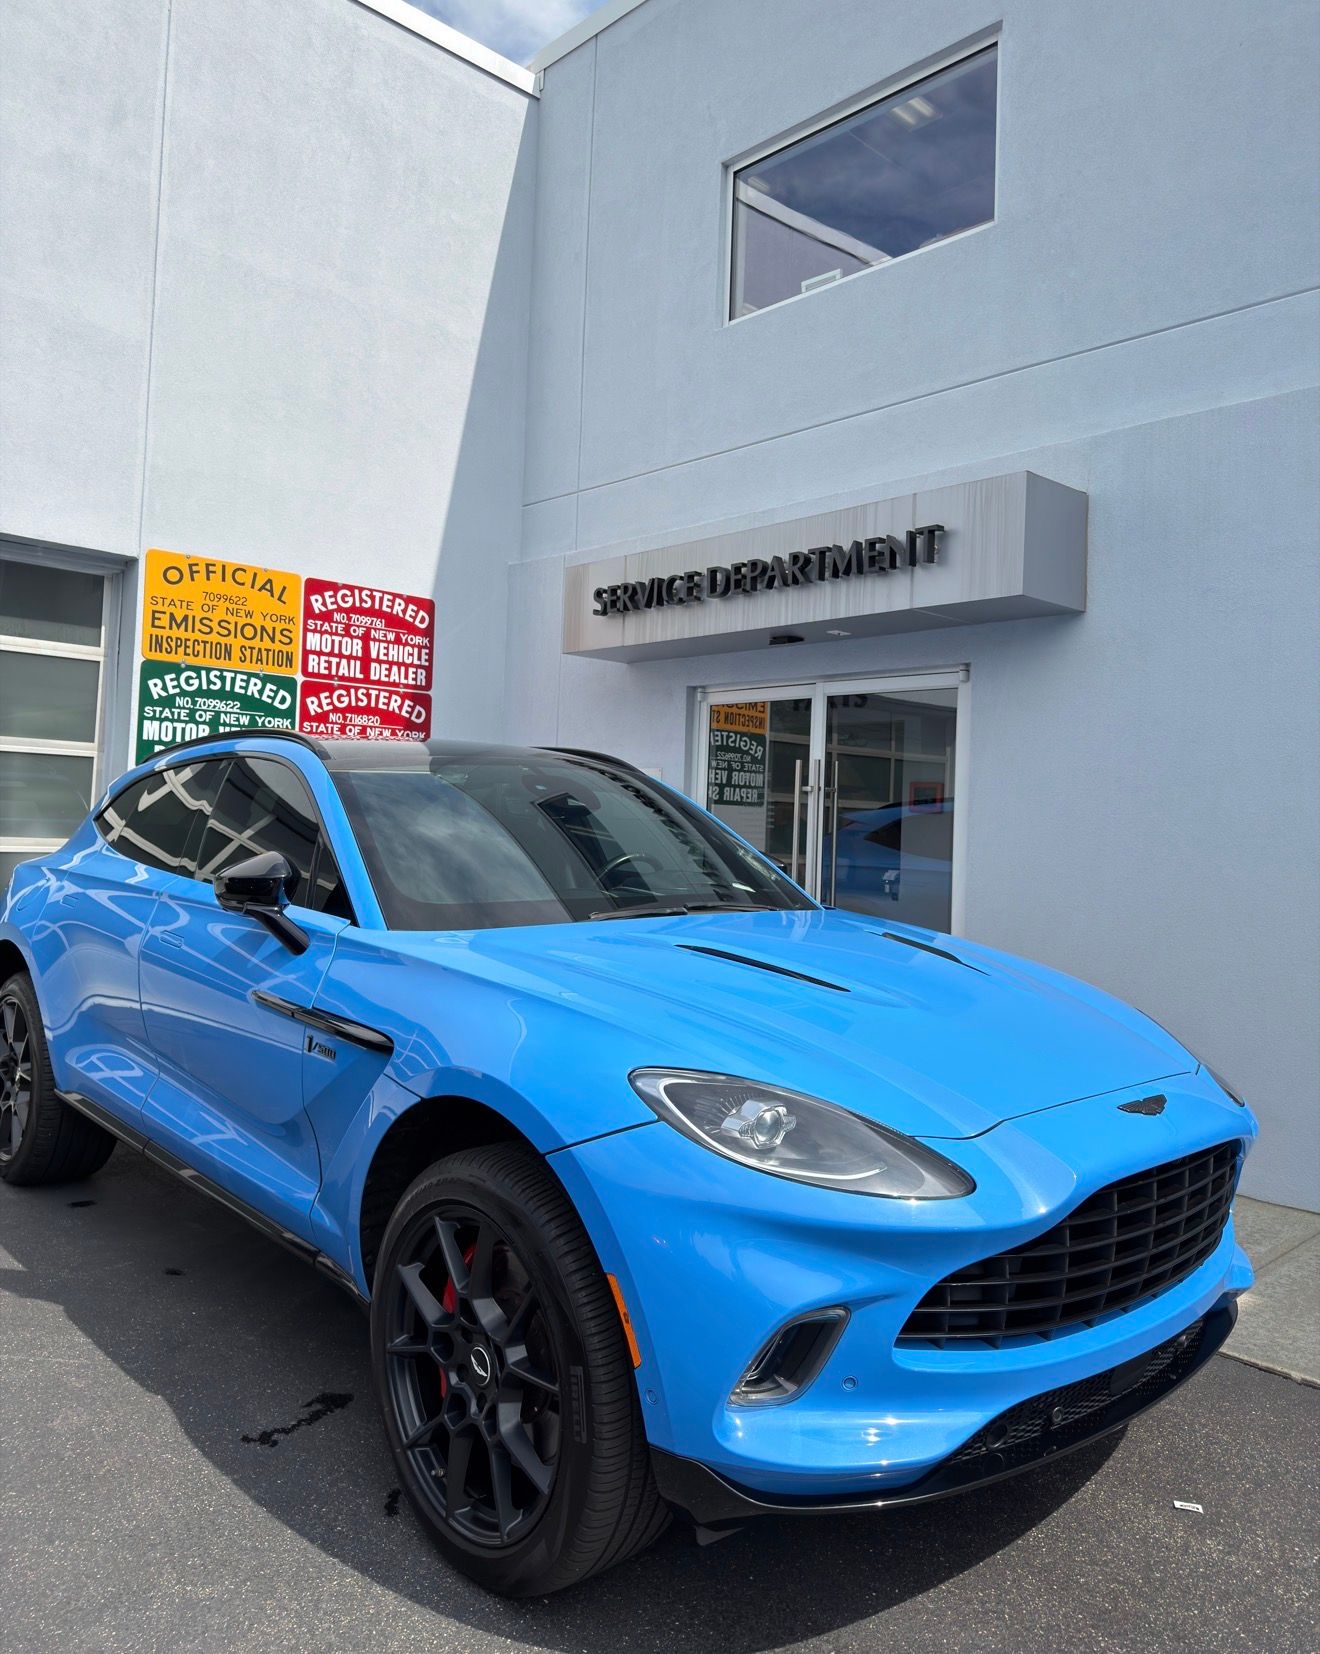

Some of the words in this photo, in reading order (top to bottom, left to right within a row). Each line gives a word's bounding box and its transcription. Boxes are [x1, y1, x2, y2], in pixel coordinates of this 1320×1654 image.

[162, 562, 287, 605] OFFICIAL
[592, 570, 704, 616] SERVICE
[706, 524, 945, 600] DEPARTMENT
[150, 595, 194, 611] STATE
[201, 603, 219, 613] OF
[225, 606, 254, 619] NEW
[260, 611, 296, 626] YORK
[202, 591, 248, 606] 7099622
[310, 589, 430, 629] REGISTERED
[151, 609, 293, 646] EMISSIONS
[306, 619, 345, 634] STATE
[350, 626, 367, 637] OF
[371, 629, 395, 641] NEW
[400, 633, 430, 647] YORK
[350, 614, 385, 628] 7099761
[149, 633, 232, 662] INSPECTION
[239, 644, 294, 669] STATION
[306, 632, 363, 657] MOTOR
[369, 641, 429, 667] VEHICLE
[307, 654, 364, 679] RETAIL
[370, 662, 426, 686] DEALER
[147, 670, 292, 710] REGISTERED
[194, 697, 241, 712] 7099622
[305, 688, 426, 724] REGISTERED
[143, 706, 190, 721] STATE
[195, 711, 215, 722] OF
[220, 713, 250, 726] NEW
[255, 716, 292, 729] YORK
[302, 721, 341, 735] STATE
[346, 726, 362, 737] OF
[366, 727, 391, 737] NEW
